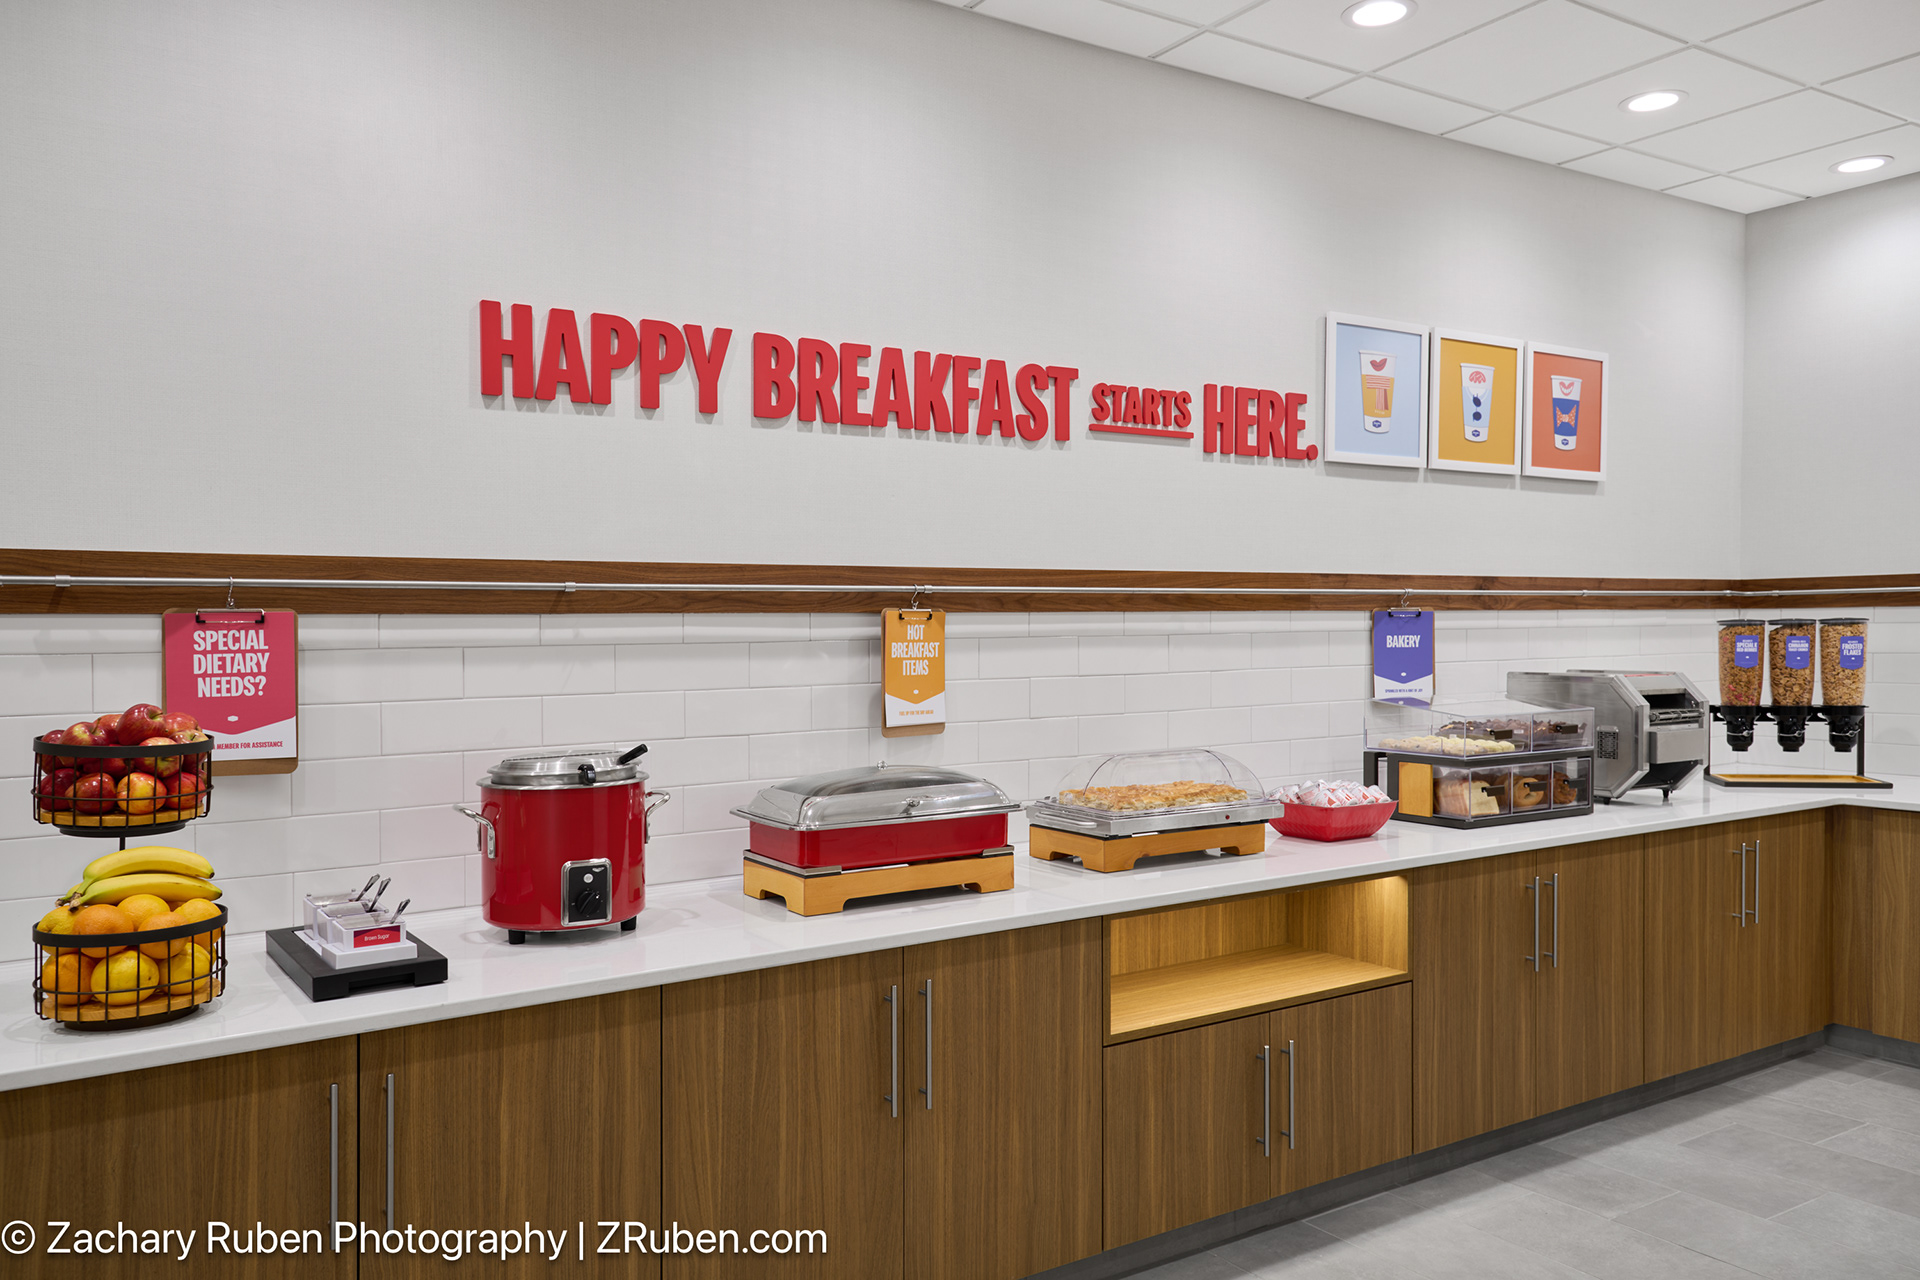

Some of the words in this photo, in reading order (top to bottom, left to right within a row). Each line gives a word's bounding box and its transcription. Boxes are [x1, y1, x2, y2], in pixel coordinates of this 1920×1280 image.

[479, 299, 732, 413] HAPPY
[753, 332, 1079, 442] BREAKFAST
[1091, 383, 1192, 428] STARTS
[1203, 383, 1318, 461] HERE.
[193, 629, 269, 651] SPECIAL
[907, 624, 925, 640] HOT
[891, 642, 940, 658] BREAKFAST
[1386, 635, 1421, 648] BAKERY
[193, 652, 270, 675] DIETARY
[902, 659, 929, 676] ITEMS
[197, 675, 267, 698] NEEDS?
[252, 741, 283, 749] ASSISTANCE
